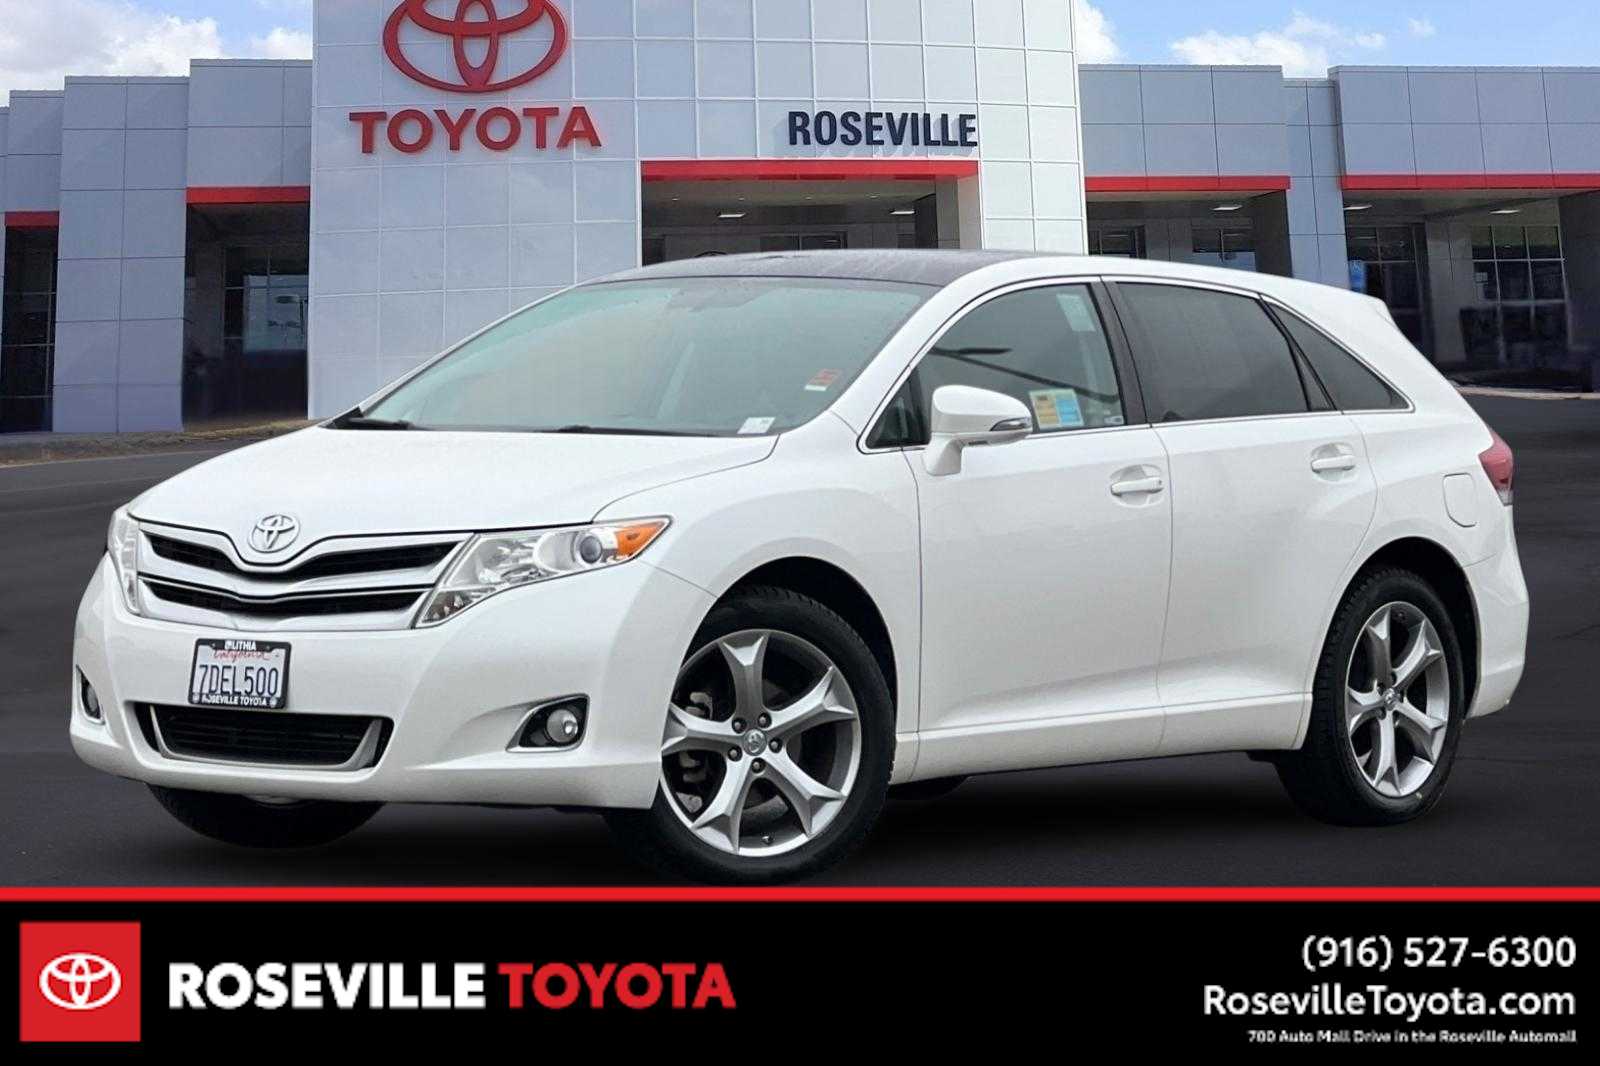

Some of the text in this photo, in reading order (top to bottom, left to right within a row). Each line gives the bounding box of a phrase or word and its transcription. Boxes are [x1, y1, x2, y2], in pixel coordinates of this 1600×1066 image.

[349, 106, 602, 154] TOYOTA
[788, 111, 978, 146] ROSEVILLE
[232, 640, 257, 651] LITHIA
[199, 664, 279, 697] 7DEL500
[240, 696, 267, 706] TOYOTA
